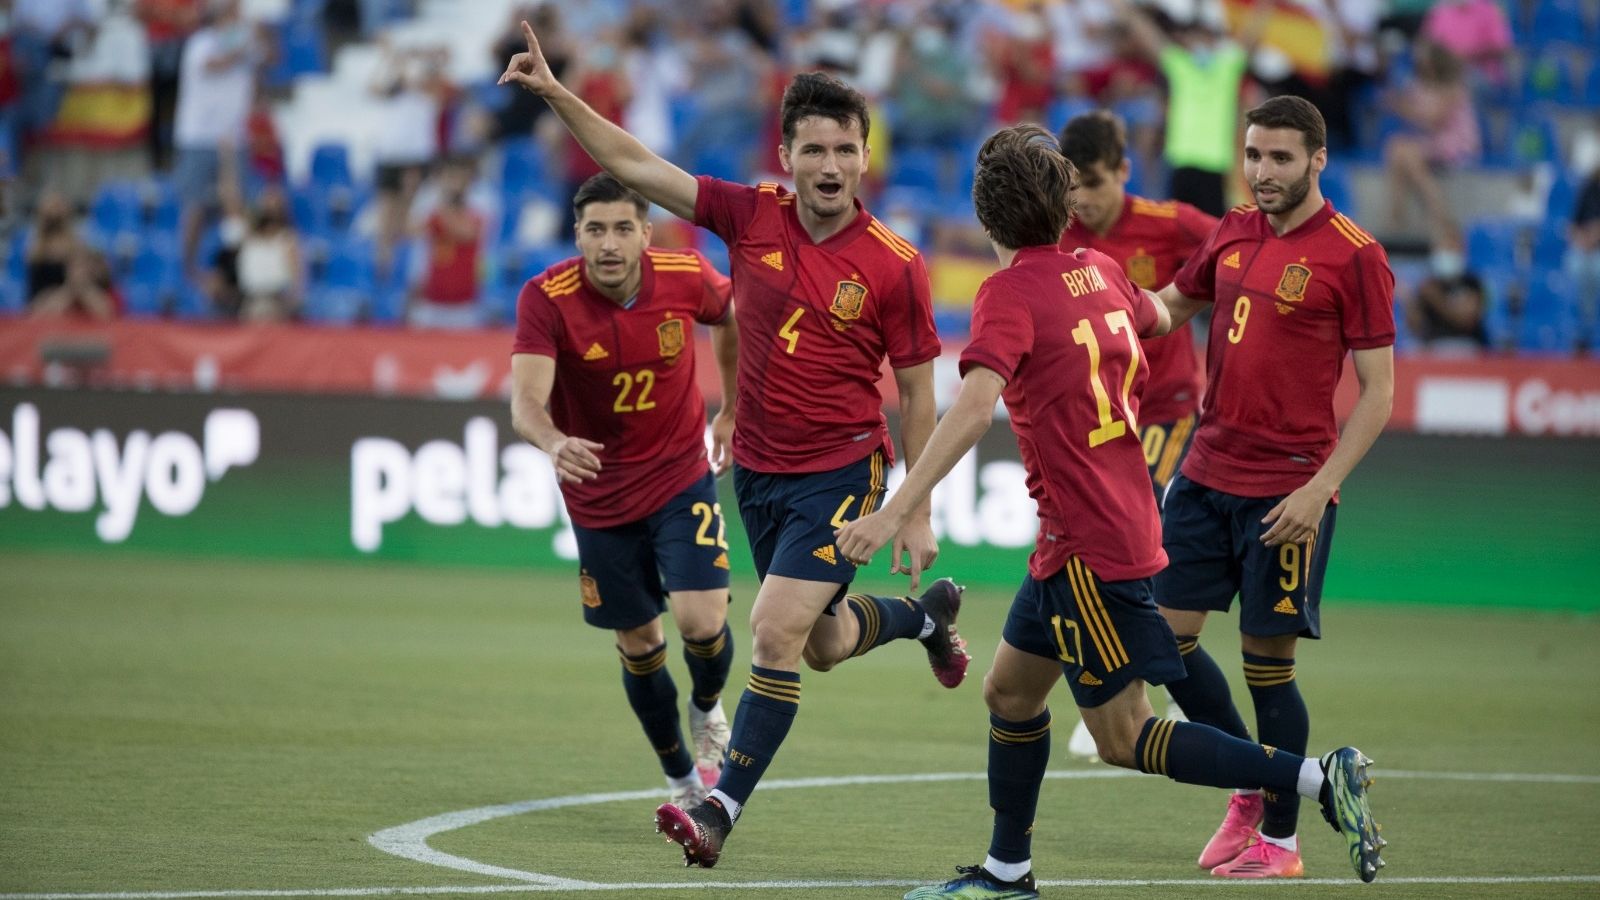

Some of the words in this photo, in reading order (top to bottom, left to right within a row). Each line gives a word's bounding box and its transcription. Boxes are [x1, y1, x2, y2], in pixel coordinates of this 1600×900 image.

[1061, 265, 1107, 299] BRYAN
[779, 308, 805, 354] 4
[1228, 296, 1251, 344] 9
[613, 369, 657, 414] 22
[1071, 310, 1140, 448] 17
[1141, 424, 1166, 467] 0
[0, 402, 206, 541] layo
[692, 501, 730, 551] 22
[1279, 543, 1300, 592] 9
[1051, 614, 1083, 667] 17
[729, 748, 755, 768] RFEF
